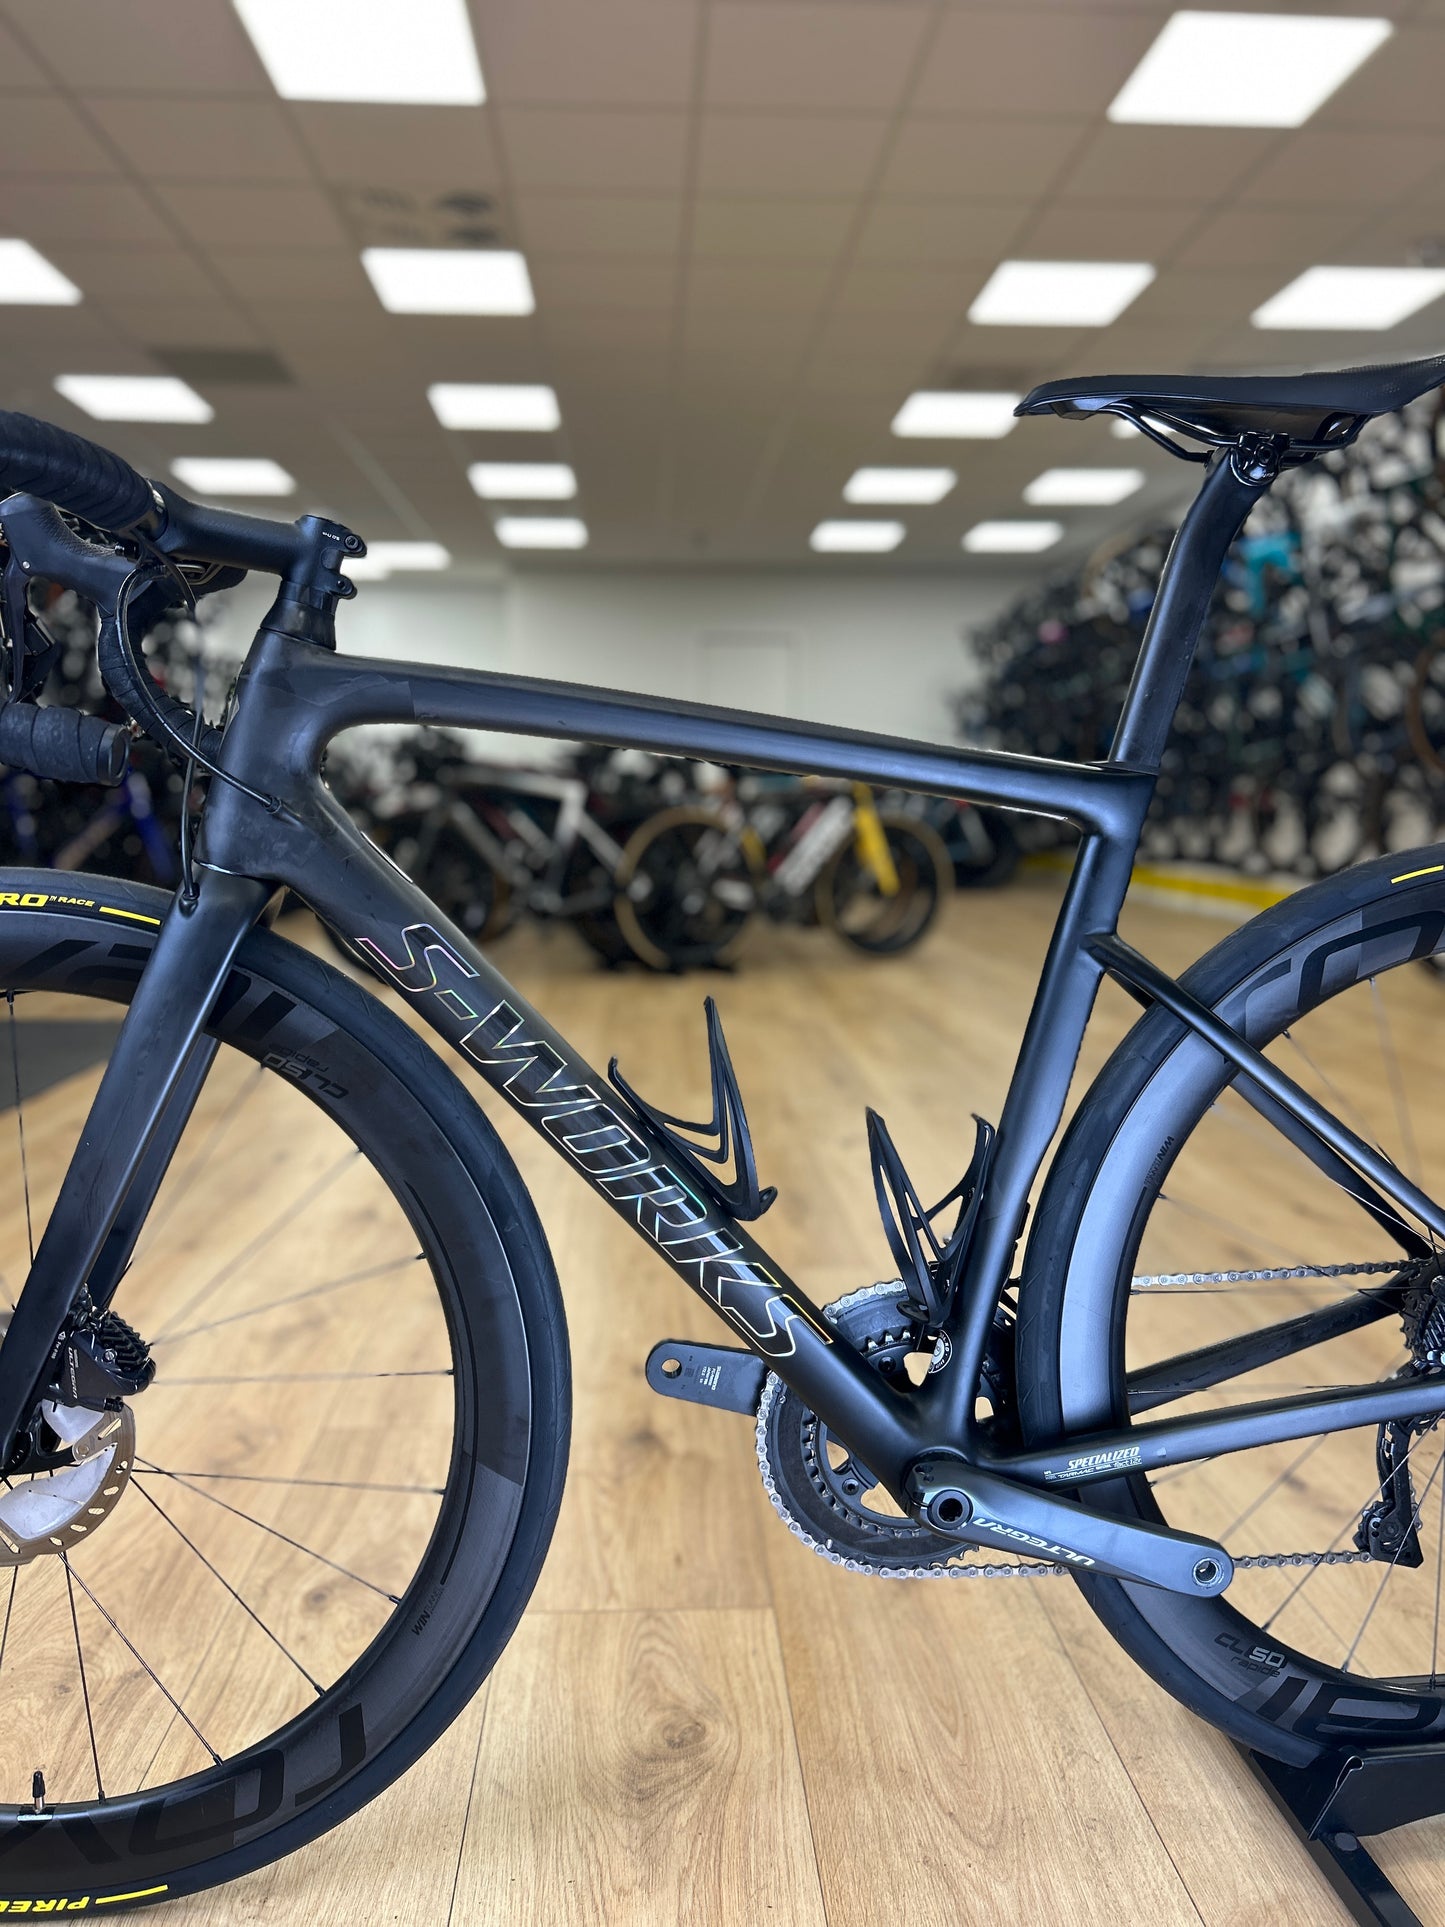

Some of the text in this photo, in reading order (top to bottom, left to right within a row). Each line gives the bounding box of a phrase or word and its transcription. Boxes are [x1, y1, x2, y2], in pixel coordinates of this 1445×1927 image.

[58, 896, 96, 908] RACE
[354, 922, 834, 1358] S-WORKS
[1067, 1446, 1140, 1470] SPECIALIZED
[972, 1518, 1096, 1566] ULTEGRA
[1231, 1656, 1281, 1678] rapide
